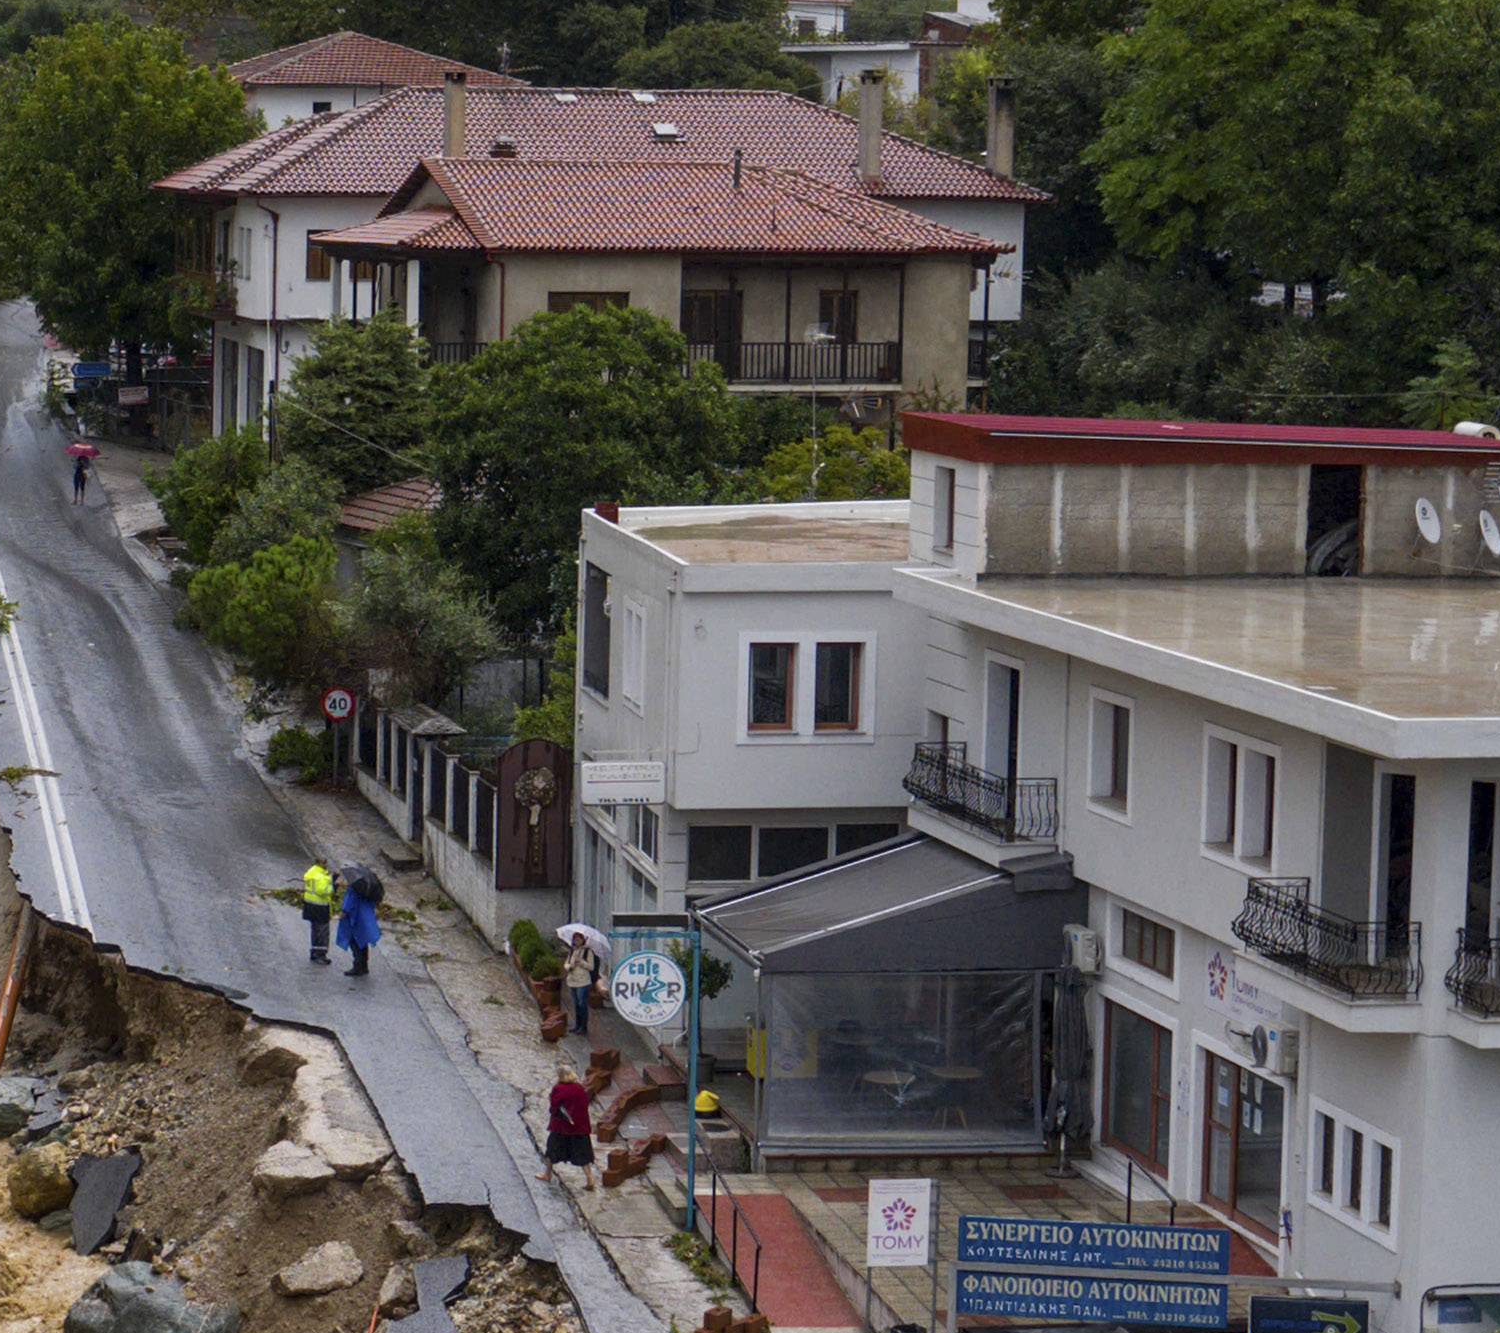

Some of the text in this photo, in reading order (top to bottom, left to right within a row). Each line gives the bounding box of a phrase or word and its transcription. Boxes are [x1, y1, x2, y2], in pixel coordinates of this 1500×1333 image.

[329, 698, 347, 710] 40
[628, 958, 660, 977] cafe
[966, 1221, 1220, 1253] ΣΥΝΕΡΓΕΙΟ ΑΥΤΟΚΙΝΗΤΩΝ
[962, 1274, 1220, 1306] ΦΑΝΟΠΟΙΕΙΟ ΑΥΤΟΚΙΝΗΤΩΝ
